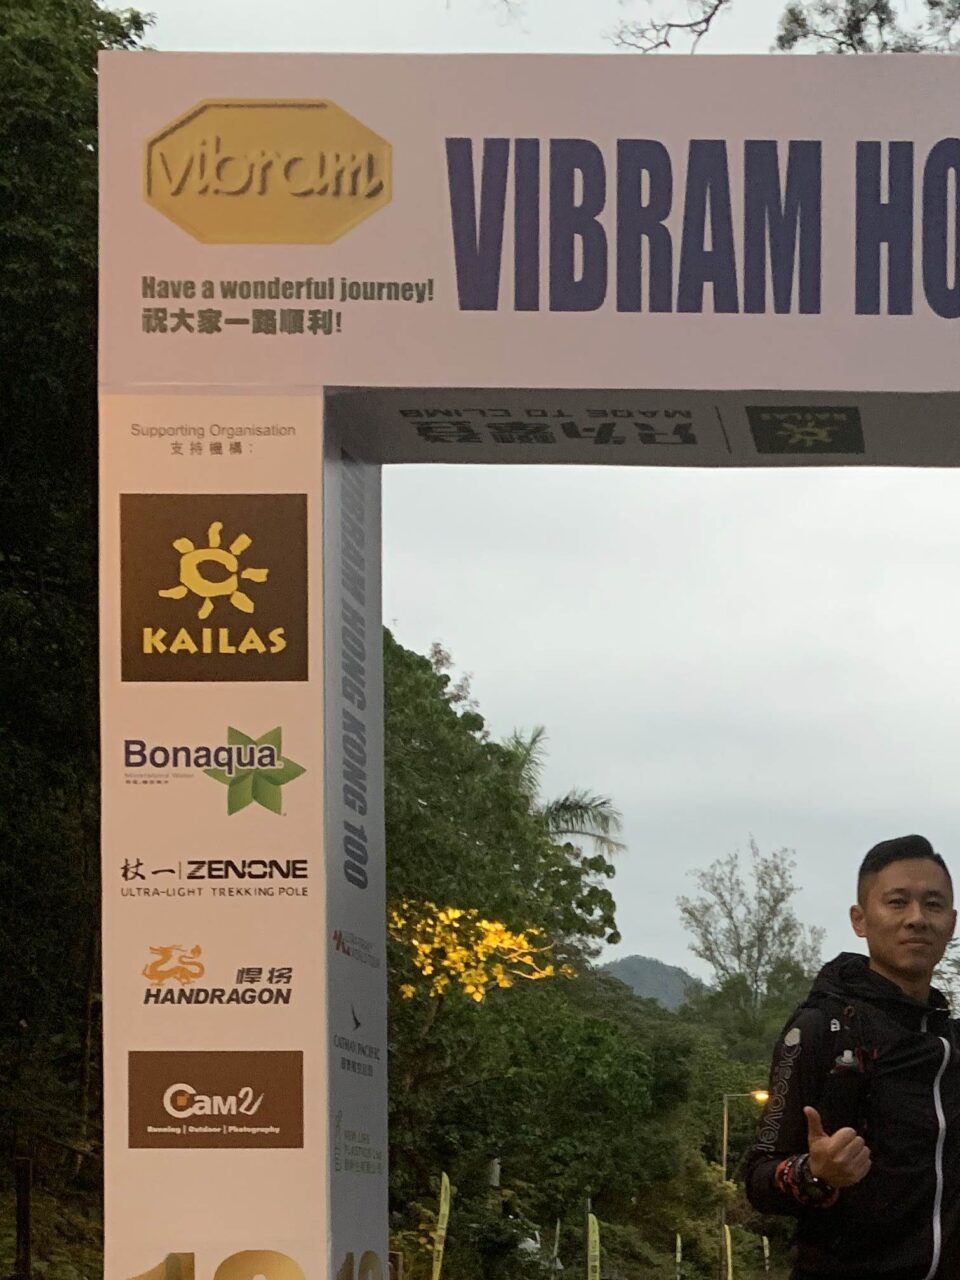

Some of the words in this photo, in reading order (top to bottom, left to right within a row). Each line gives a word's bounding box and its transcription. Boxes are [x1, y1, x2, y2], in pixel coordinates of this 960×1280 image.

[158, 135, 386, 199] vibram
[445, 137, 822, 314] VIBRAM
[142, 276, 198, 299] Have
[201, 282, 214, 299] a
[219, 277, 335, 300] wonderful
[339, 279, 434, 303] journey!
[131, 423, 205, 437] Supporting
[209, 423, 296, 437] Organisation
[341, 462, 367, 607] VIBRAM
[142, 626, 287, 654] KAILAS
[341, 597, 367, 712] HONG
[124, 739, 277, 775] Bonaqua
[341, 707, 368, 817] KONG
[186, 859, 309, 880] ZENONE
[343, 820, 369, 890] 100
[121, 887, 203, 897] ULTRA-LIGHT
[211, 887, 275, 897] TREKKING
[279, 887, 308, 897] POLE
[143, 988, 292, 1005] HANDRAGON
